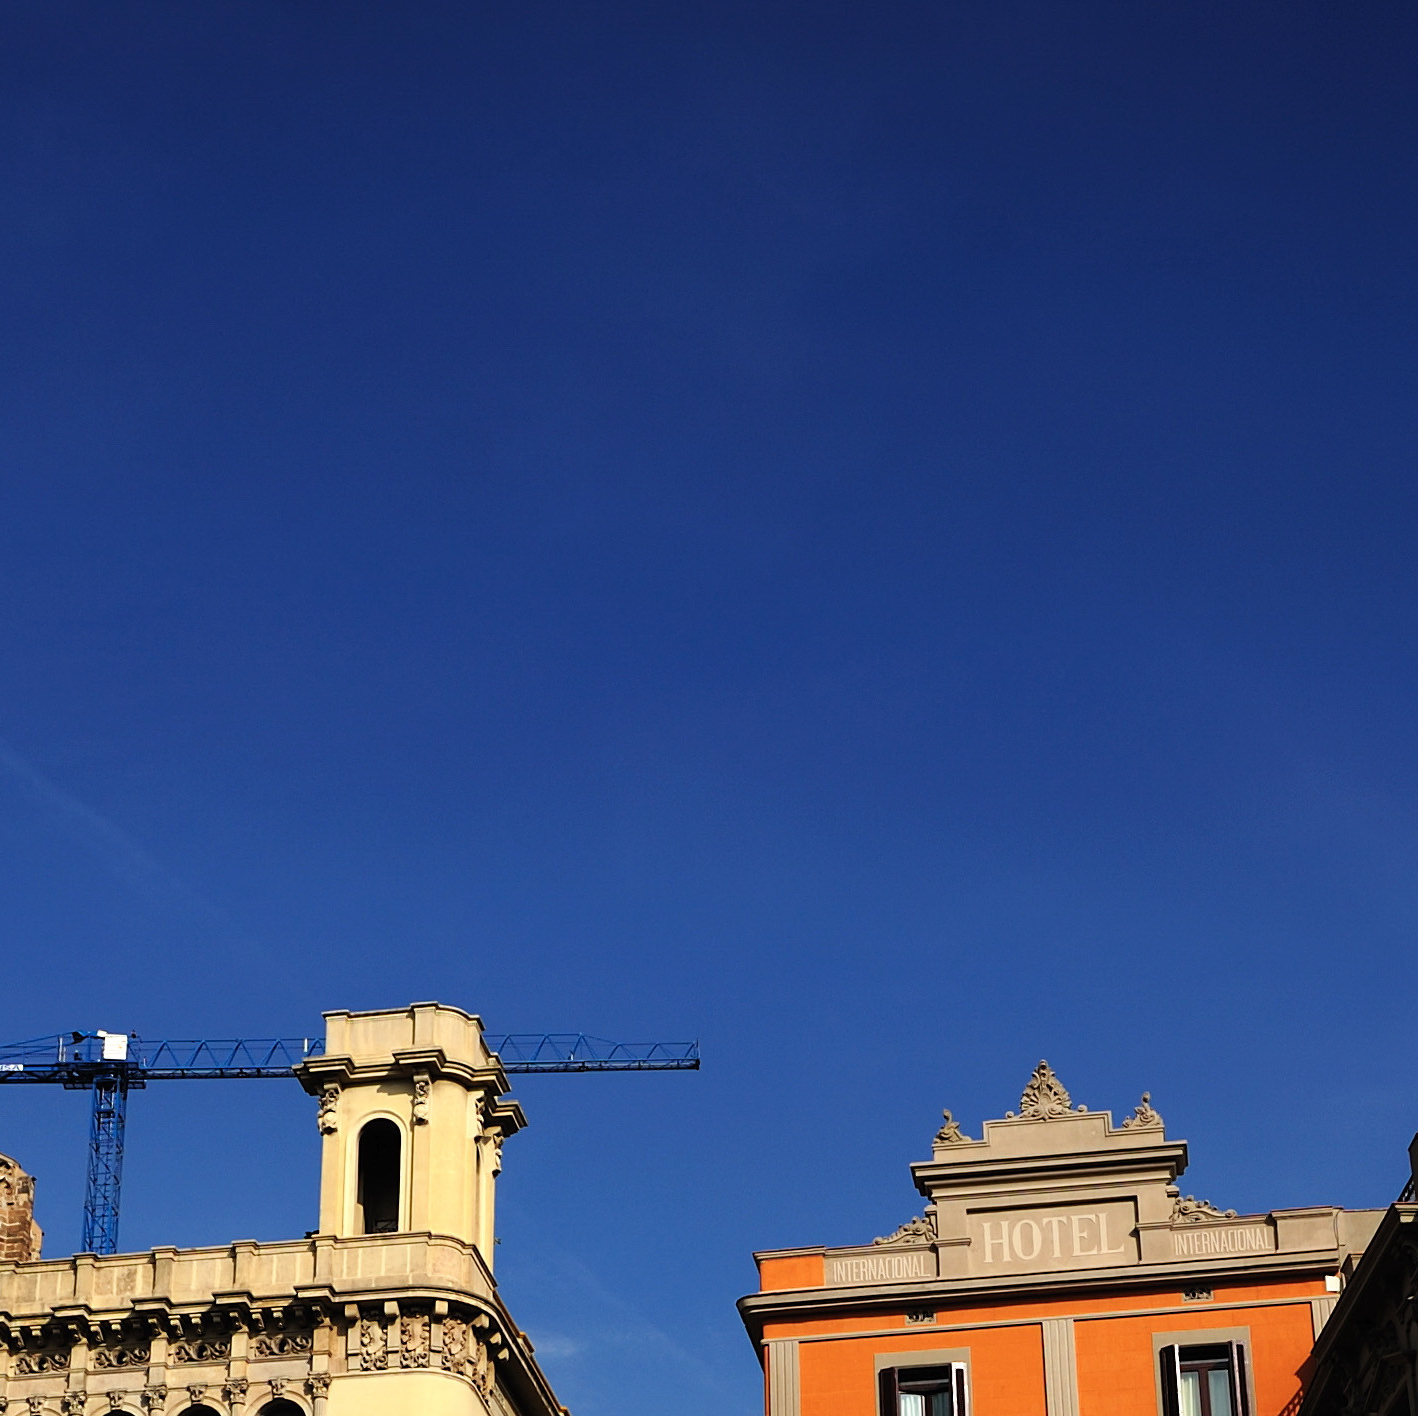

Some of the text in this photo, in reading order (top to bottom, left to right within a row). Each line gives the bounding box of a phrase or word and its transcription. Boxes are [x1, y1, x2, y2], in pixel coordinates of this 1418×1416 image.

[982, 1213, 1125, 1263] HOTEL
[1173, 1228, 1272, 1256] INTERNACIONAL
[833, 1255, 931, 1283] INTERNACIONAL
